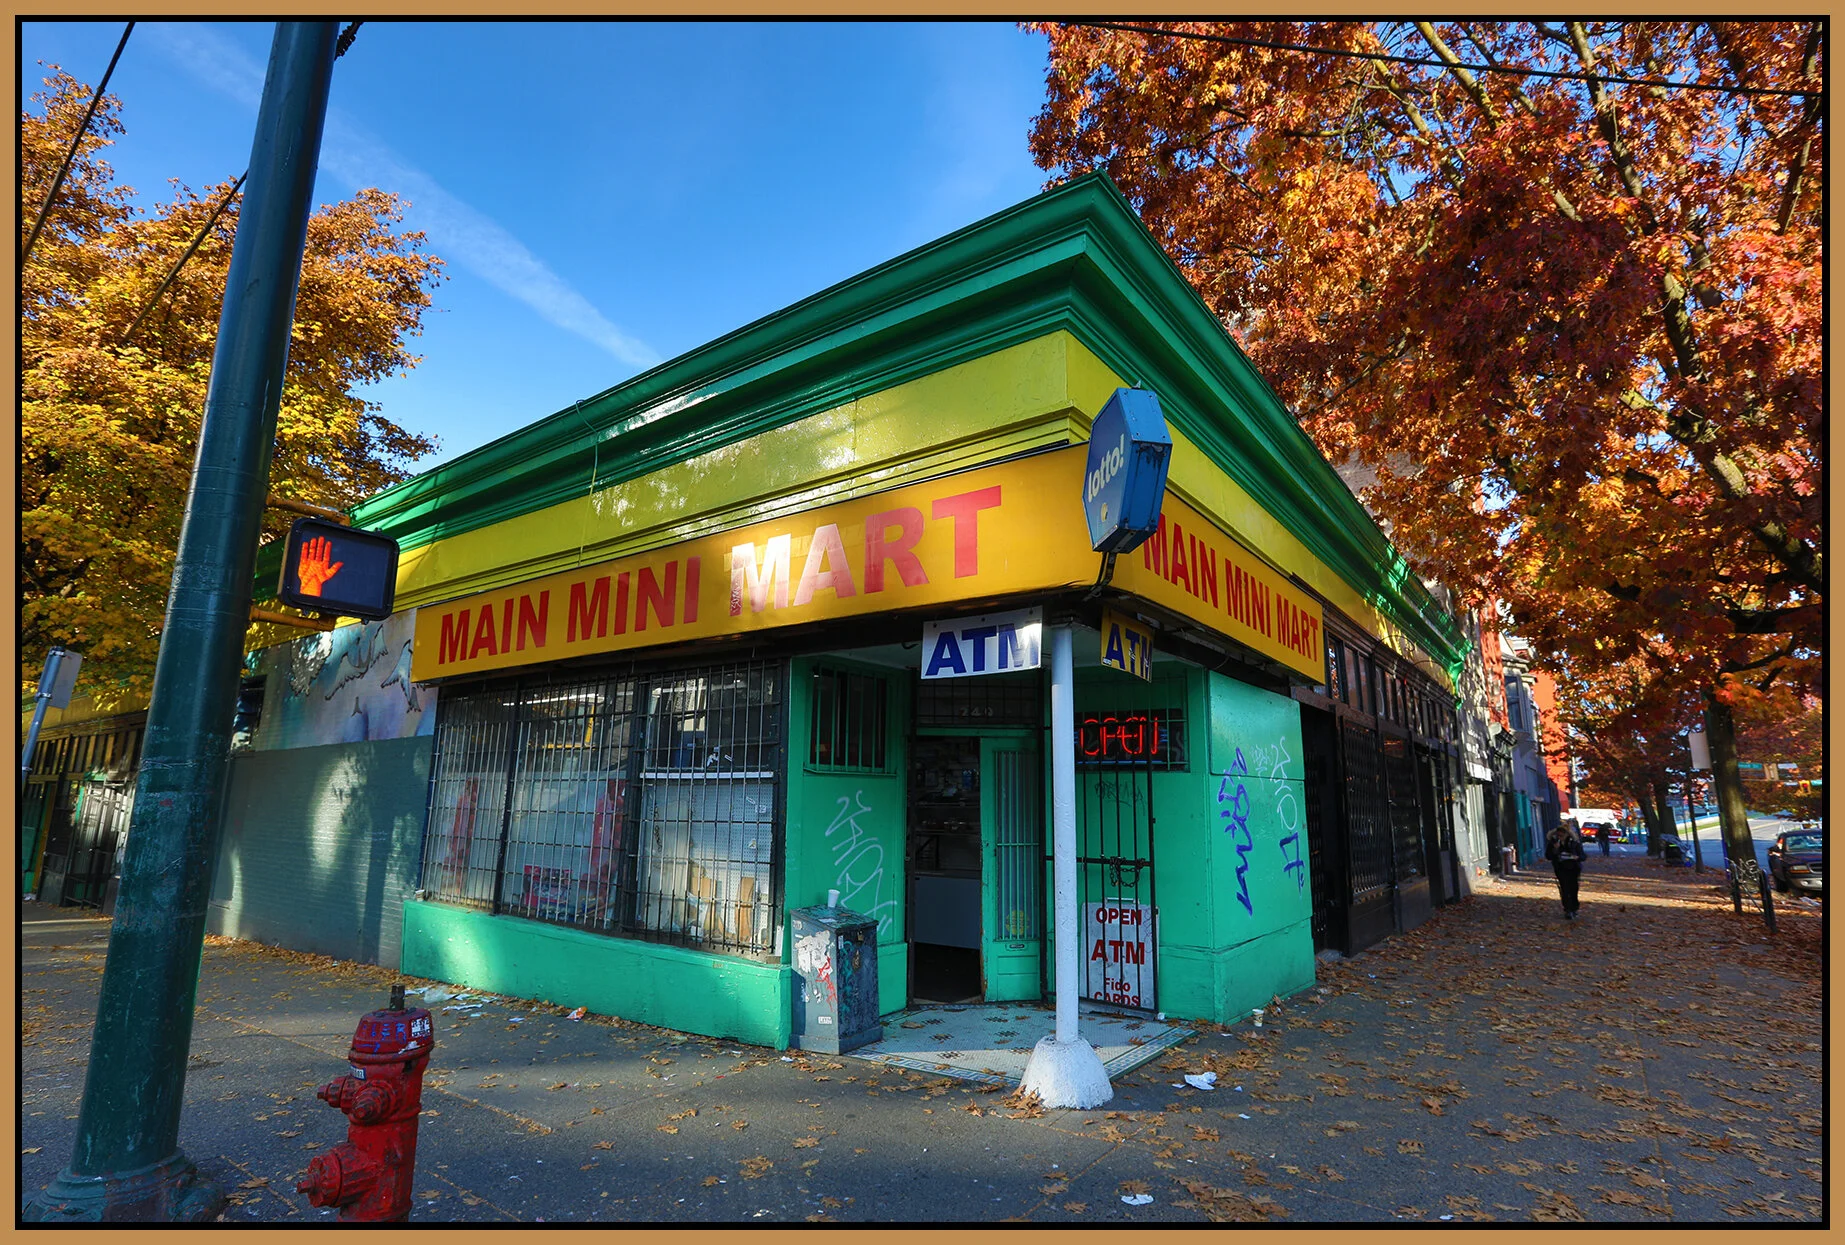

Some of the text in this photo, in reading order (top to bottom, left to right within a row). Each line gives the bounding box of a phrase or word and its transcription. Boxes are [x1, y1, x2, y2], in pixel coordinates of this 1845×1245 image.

[1088, 433, 1125, 503] lotto!
[438, 485, 1002, 664] MAIN MINI MART
[1143, 513, 1319, 662] MAIN MINI MART
[925, 623, 1040, 676] ATM
[1079, 716, 1159, 757] OPEN
[1095, 907, 1142, 926] OPEN
[1091, 939, 1146, 965] ATM
[1104, 977, 1131, 992] Fido
